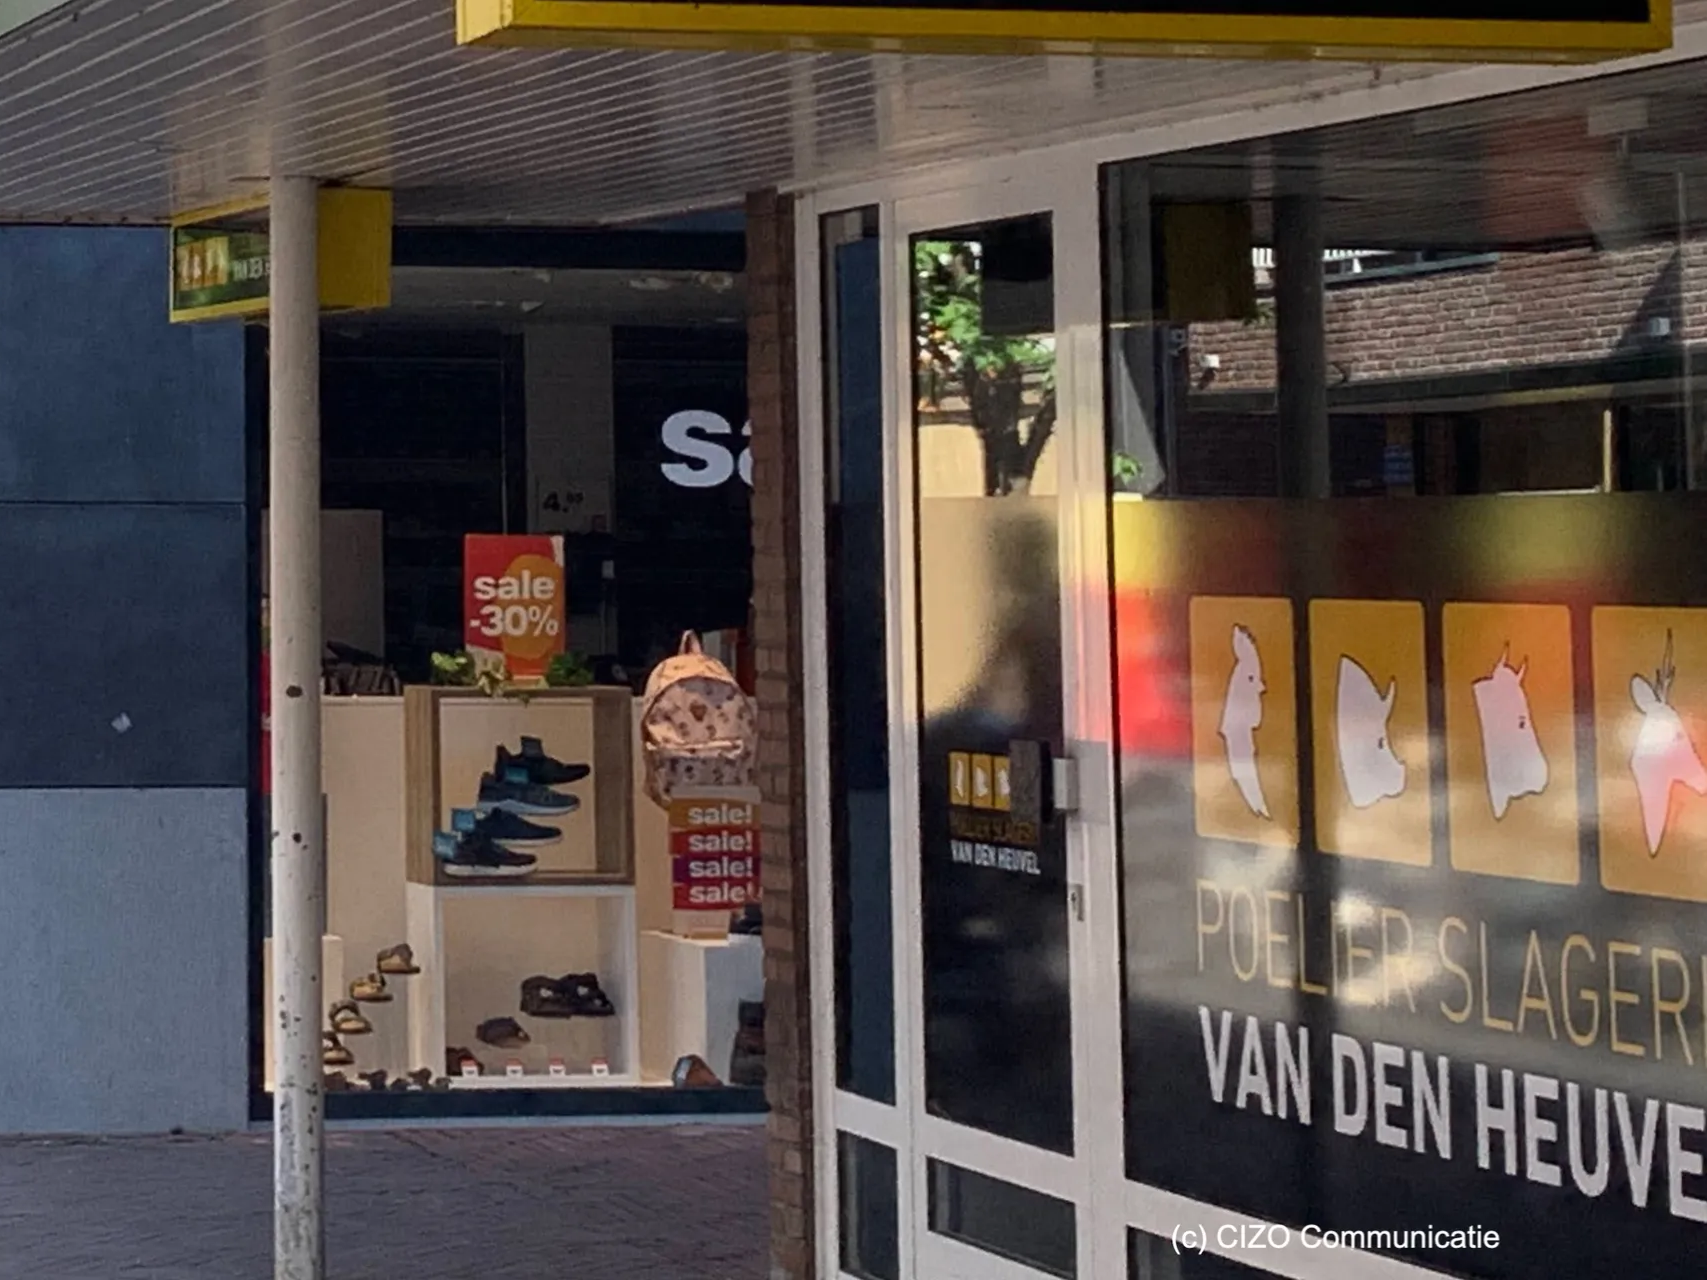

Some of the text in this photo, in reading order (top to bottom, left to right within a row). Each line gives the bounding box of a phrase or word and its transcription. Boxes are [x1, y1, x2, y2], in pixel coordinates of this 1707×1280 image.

[660, 409, 753, 487] s
[473, 569, 555, 600] sale
[469, 604, 560, 637] -30%
[688, 803, 753, 825] sale!
[688, 830, 753, 852] sale!
[951, 839, 973, 863] VAN
[689, 855, 754, 878] sale!
[1196, 878, 1416, 1013] POELIER
[1198, 1004, 1707, 1223] VAN DEN HEUVE
